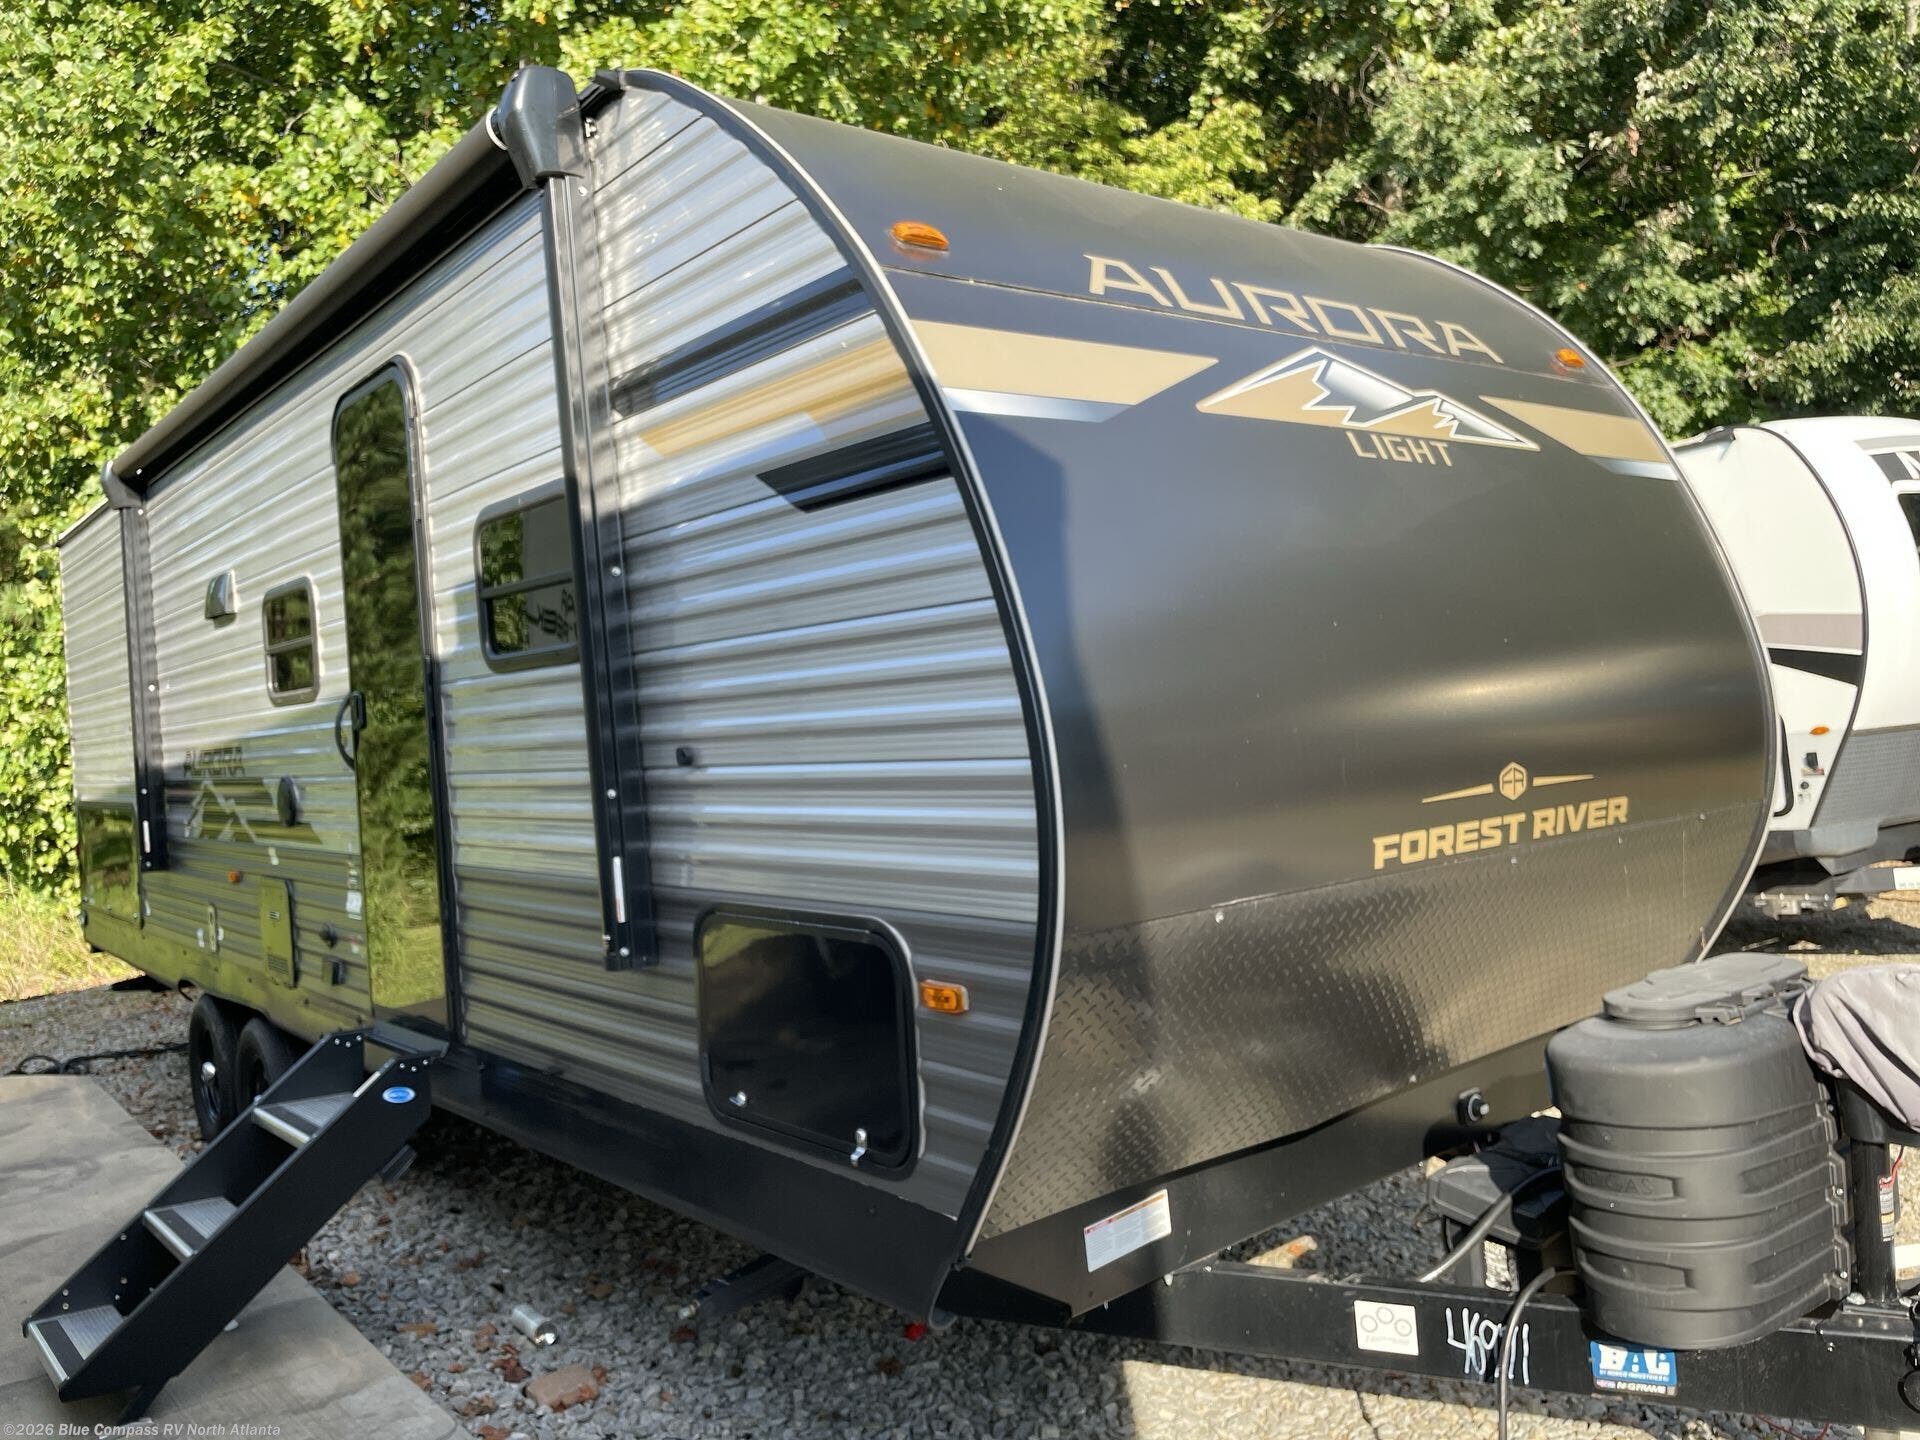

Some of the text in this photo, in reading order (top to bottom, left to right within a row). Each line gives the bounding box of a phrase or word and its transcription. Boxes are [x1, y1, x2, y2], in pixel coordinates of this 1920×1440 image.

[1084, 254, 1504, 364] AURORA
[1345, 430, 1453, 468] LIGHT
[1371, 795, 1629, 871] FOREST RIVER
